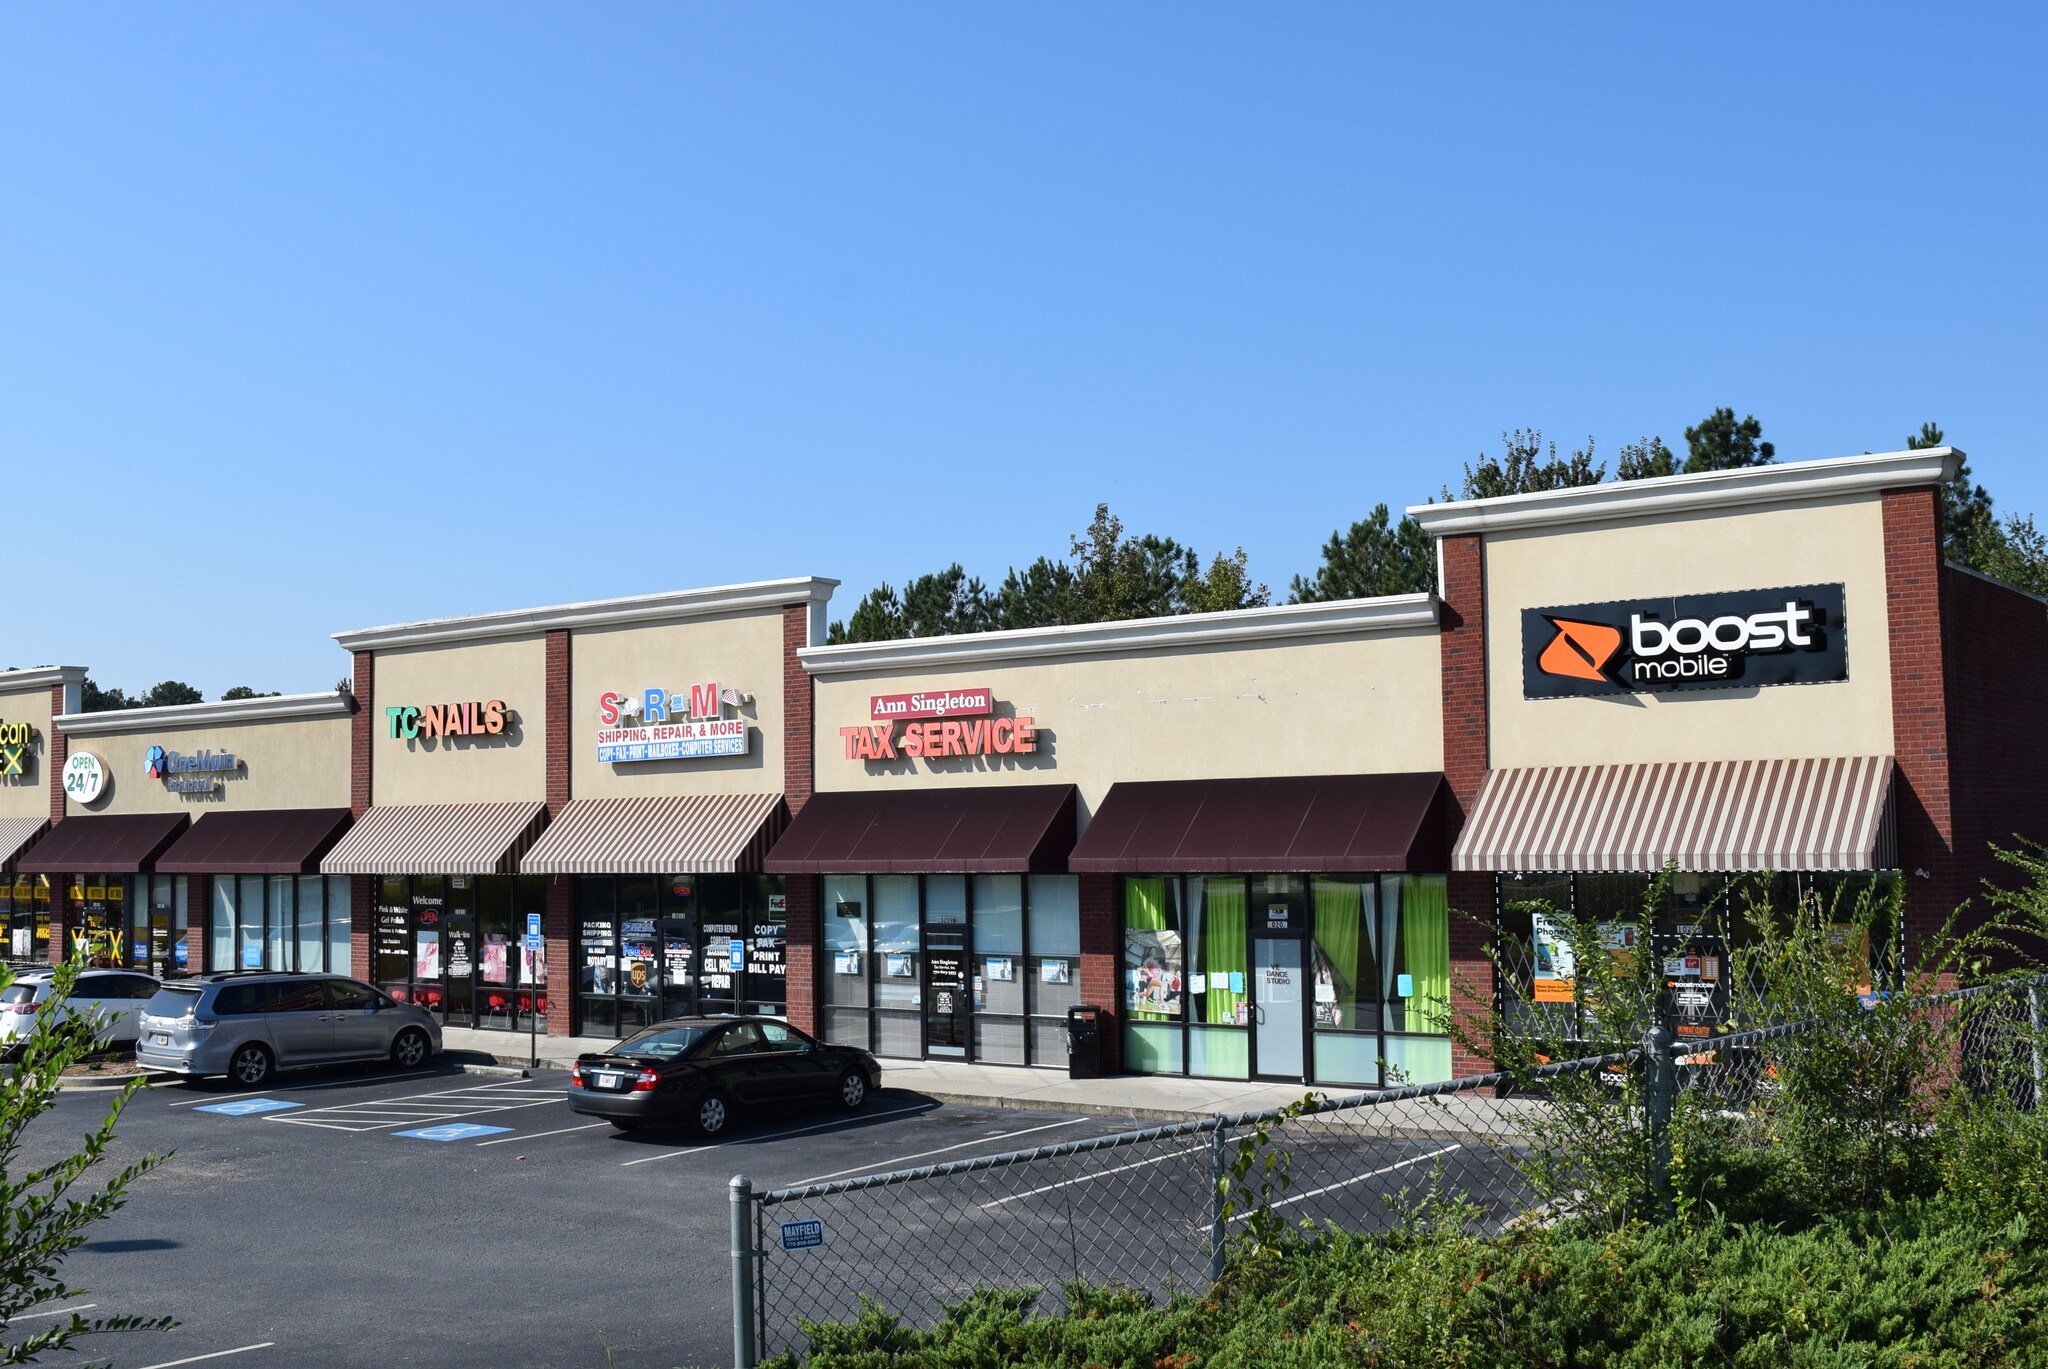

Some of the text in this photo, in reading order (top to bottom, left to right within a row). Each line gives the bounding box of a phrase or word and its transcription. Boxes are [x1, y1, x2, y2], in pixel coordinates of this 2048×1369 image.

[1631, 601, 1811, 657] boost
[1635, 654, 1727, 679] mobile
[643, 687, 667, 723] R
[690, 681, 720, 719] M
[873, 692, 986, 715] Ann Singleton
[599, 690, 620, 726] S
[386, 700, 505, 739] TC NAILS
[598, 721, 743, 744] SHIPPING, REPAIR, & MORE
[840, 717, 1034, 760] TAX SERVICE
[714, 738, 743, 753] SERVICES
[72, 756, 95, 770] OPEN
[167, 748, 238, 773] OneMain
[67, 771, 98, 794] 24/7
[412, 895, 443, 905] Welcome
[770, 898, 786, 909] FedE
[378, 905, 389, 913] Pink
[393, 906, 408, 914] White
[381, 916, 405, 924] Gel Polish
[703, 924, 738, 933] COMPUTER REPAIR
[754, 925, 779, 935] COPY
[1536, 927, 1569, 936] Phones
[710, 936, 731, 945] COMPUTER
[623, 943, 653, 957] FedEx
[753, 951, 780, 961] PRINT
[587, 956, 606, 966] NOTARY
[704, 958, 717, 972] CELL
[748, 963, 786, 975] BILL PAY
[632, 970, 645, 983] ups
[711, 975, 731, 989] REPAIR
[784, 1223, 820, 1237] MAYFIELD
